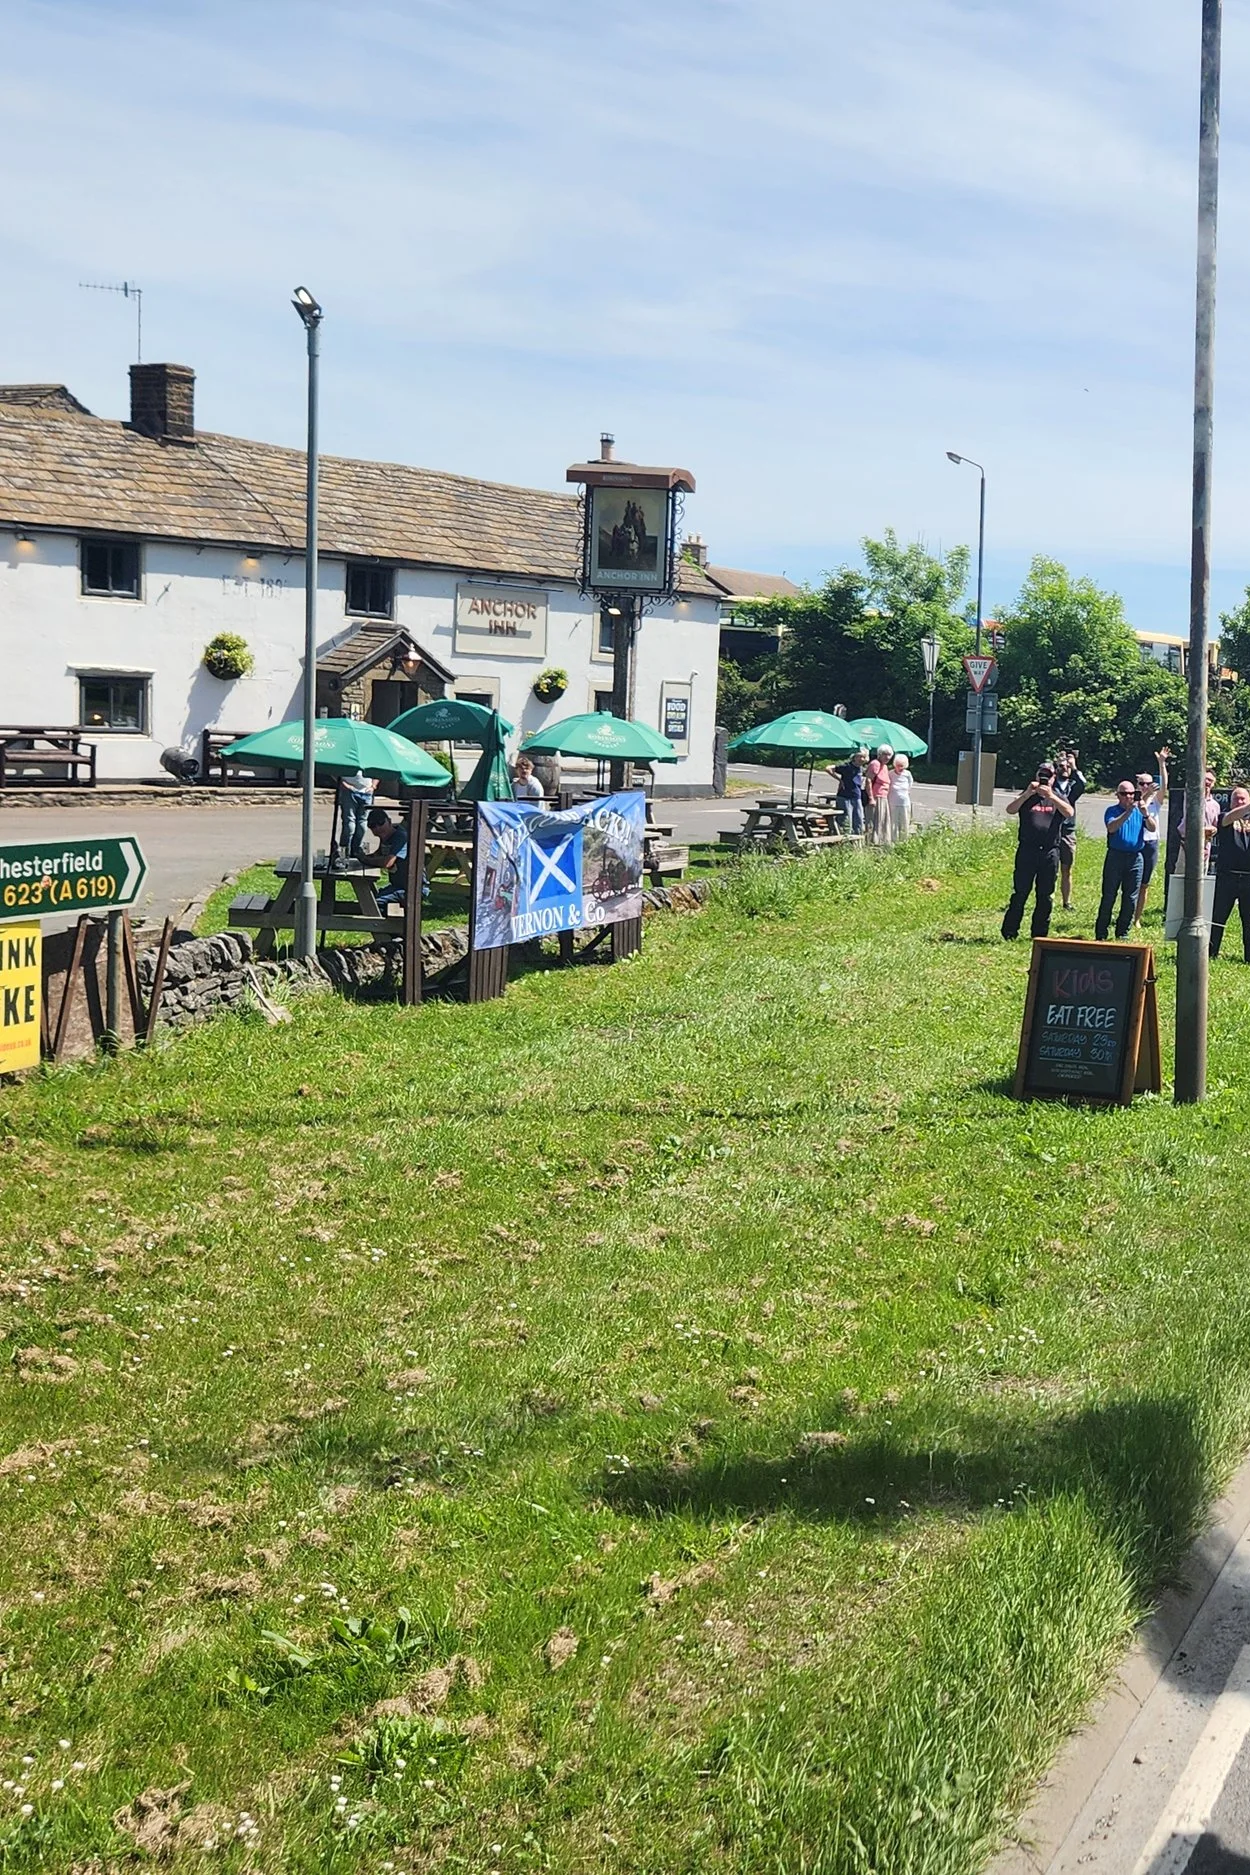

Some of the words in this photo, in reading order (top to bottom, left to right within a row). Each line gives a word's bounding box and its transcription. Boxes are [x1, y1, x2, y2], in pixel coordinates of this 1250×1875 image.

[596, 571, 638, 580] ANCHOR
[640, 573, 658, 581] INN
[468, 597, 537, 619] ANCHOR
[488, 619, 517, 636] INN
[970, 661, 988, 669] GIVE
[4, 882, 42, 906] 623
[50, 879, 73, 904] (A
[76, 875, 116, 899] 619)
[511, 905, 564, 939] VERNON
[568, 903, 581, 926] &
[585, 899, 605, 924] Co
[1054, 964, 1114, 998] Kids
[1046, 1004, 1074, 1025] EAT
[1076, 1005, 1117, 1029] FREE
[1041, 1030, 1088, 1045] SATURDAY
[1039, 1045, 1082, 1059] SATURDAY
